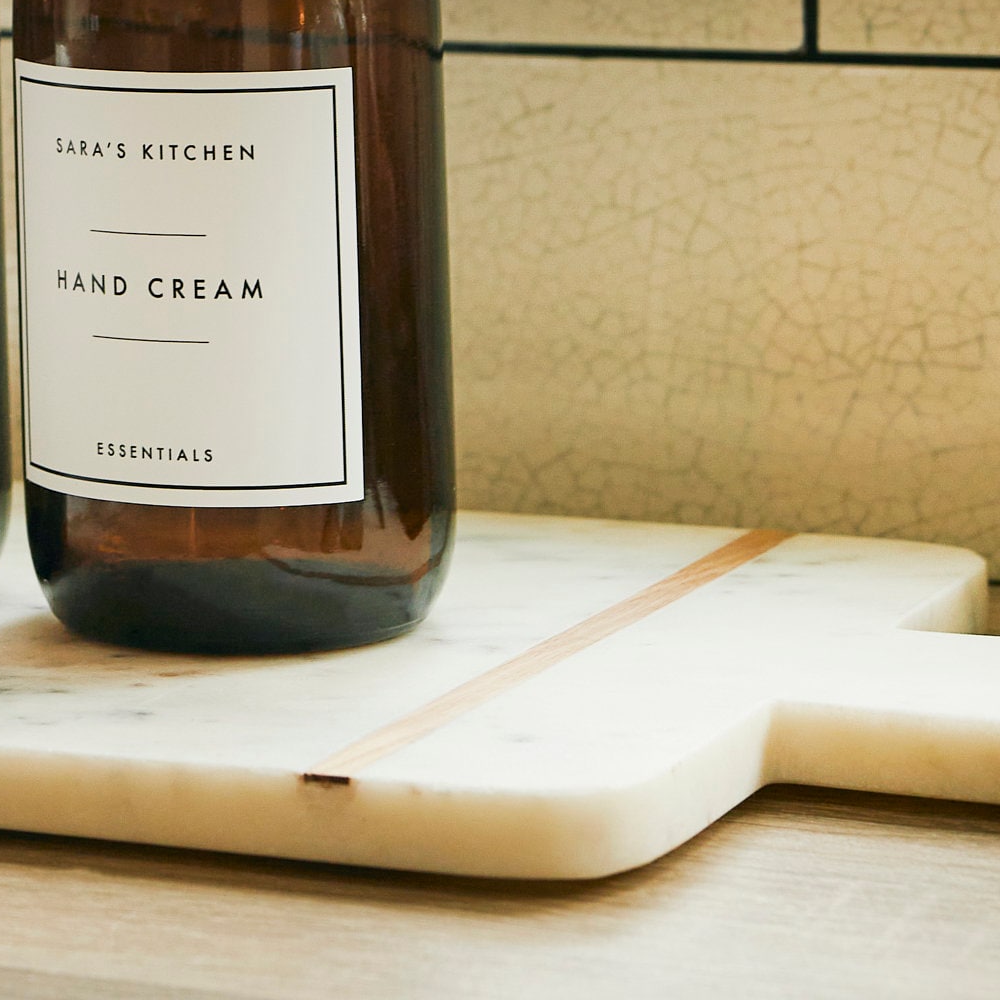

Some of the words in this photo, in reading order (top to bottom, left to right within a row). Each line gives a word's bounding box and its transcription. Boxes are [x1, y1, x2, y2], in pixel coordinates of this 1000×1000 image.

[55, 137, 127, 160] SARA'S
[141, 143, 256, 162] KITCHEN
[56, 268, 129, 297] HAND
[147, 277, 264, 301] CREAM
[96, 441, 214, 463] ESSENTIALS
